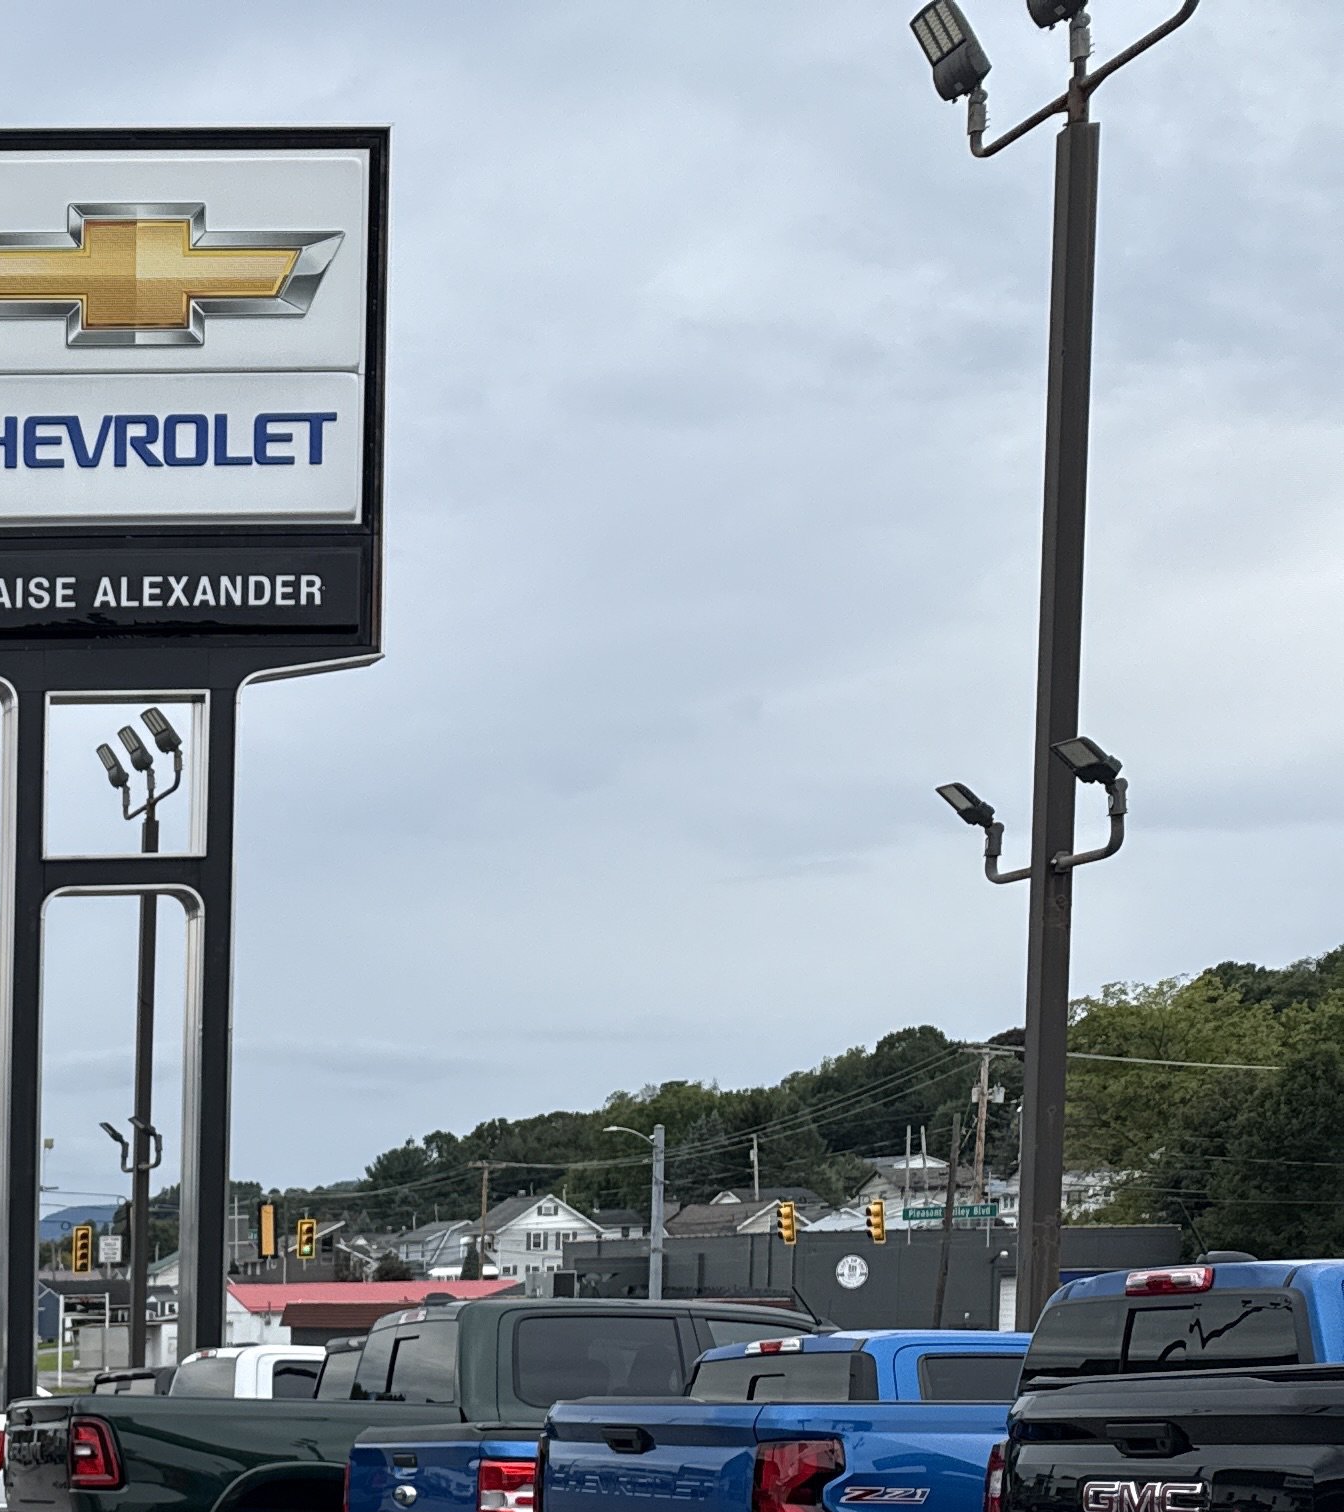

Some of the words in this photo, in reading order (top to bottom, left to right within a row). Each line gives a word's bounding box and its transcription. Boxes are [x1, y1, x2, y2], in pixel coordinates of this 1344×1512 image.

[93, 574, 324, 607] ALEXANDER
[908, 1207, 943, 1218] Pleasant
[973, 1205, 991, 1216] Blvd
[839, 1485, 931, 1505] Z71
